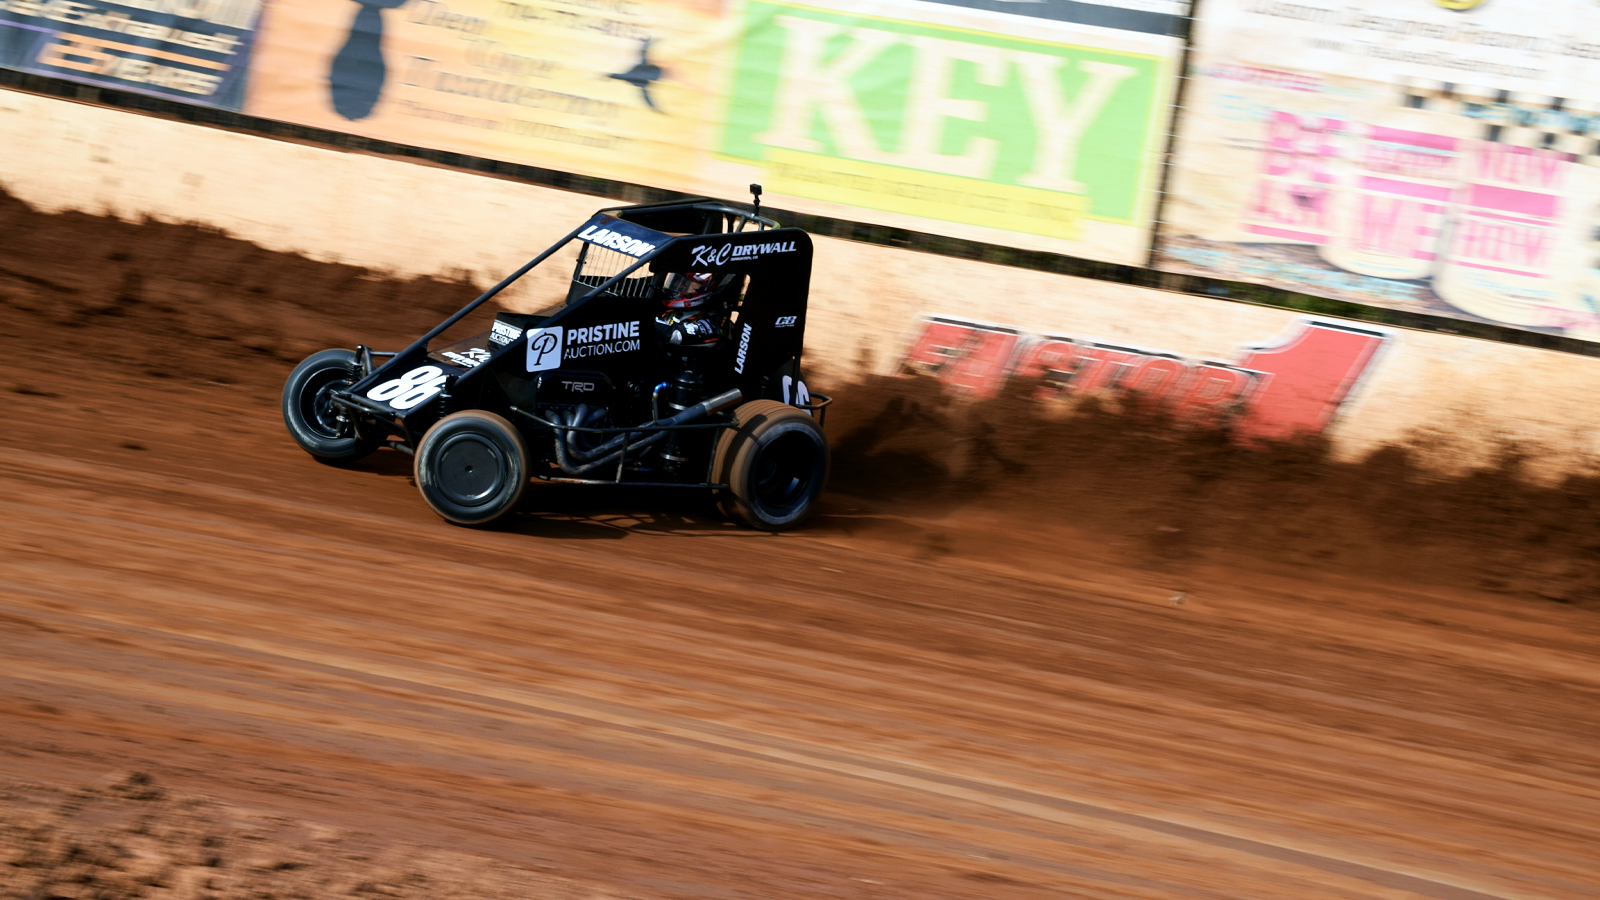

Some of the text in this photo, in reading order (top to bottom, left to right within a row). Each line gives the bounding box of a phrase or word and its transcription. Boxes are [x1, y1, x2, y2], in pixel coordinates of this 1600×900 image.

[750, 14, 1139, 195] KEY
[577, 224, 656, 257] LARSON
[691, 241, 797, 267] K&C DRYWALL
[491, 321, 522, 340] PRISTINE
[567, 320, 640, 346] PRISTINE
[563, 339, 641, 360] AUCTION.COM
[734, 323, 753, 375] LARSON
[366, 365, 448, 410] 86
[561, 380, 595, 393] TRD
